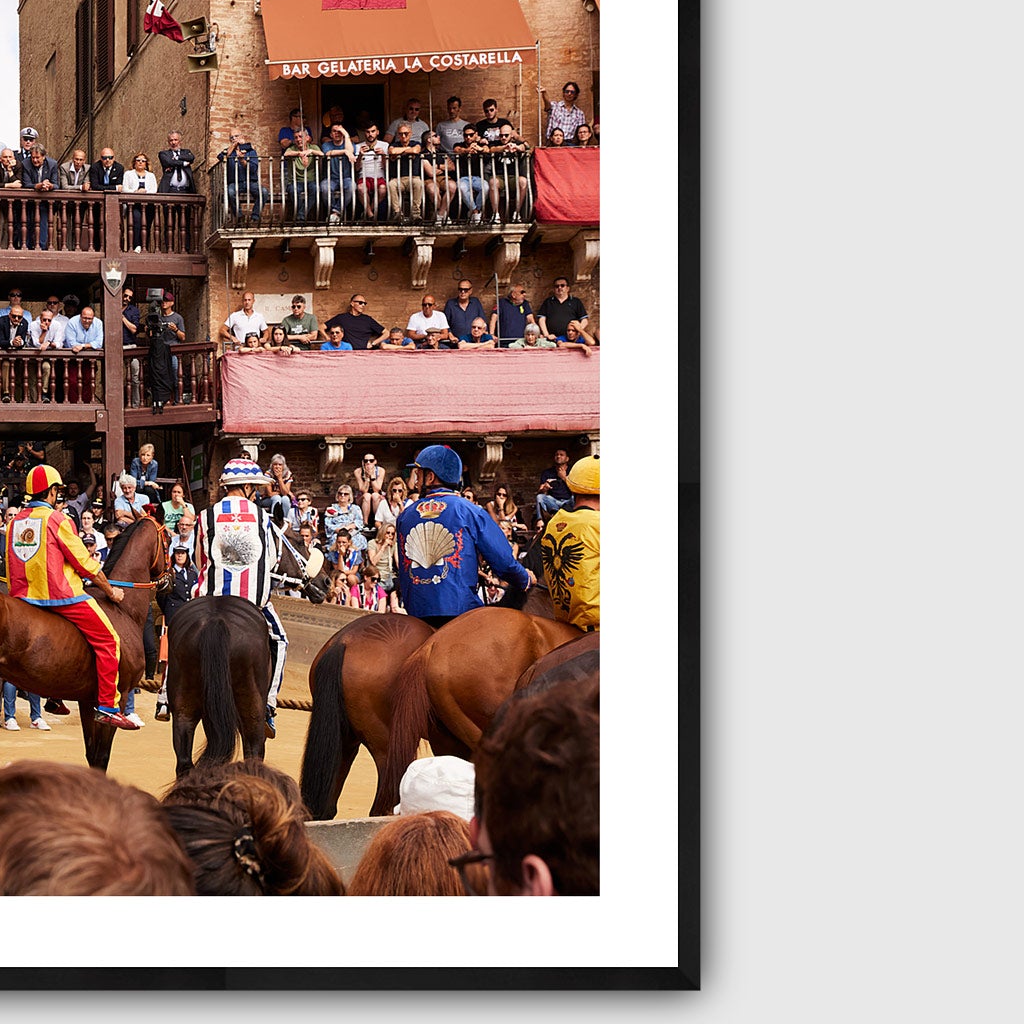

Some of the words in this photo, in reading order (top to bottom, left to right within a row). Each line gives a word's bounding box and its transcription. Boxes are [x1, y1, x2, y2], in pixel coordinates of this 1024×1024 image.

[282, 63, 310, 76] BAR
[317, 58, 397, 74] GELATERIA
[404, 56, 423, 69] LA
[429, 51, 523, 68] COSTARELLA
